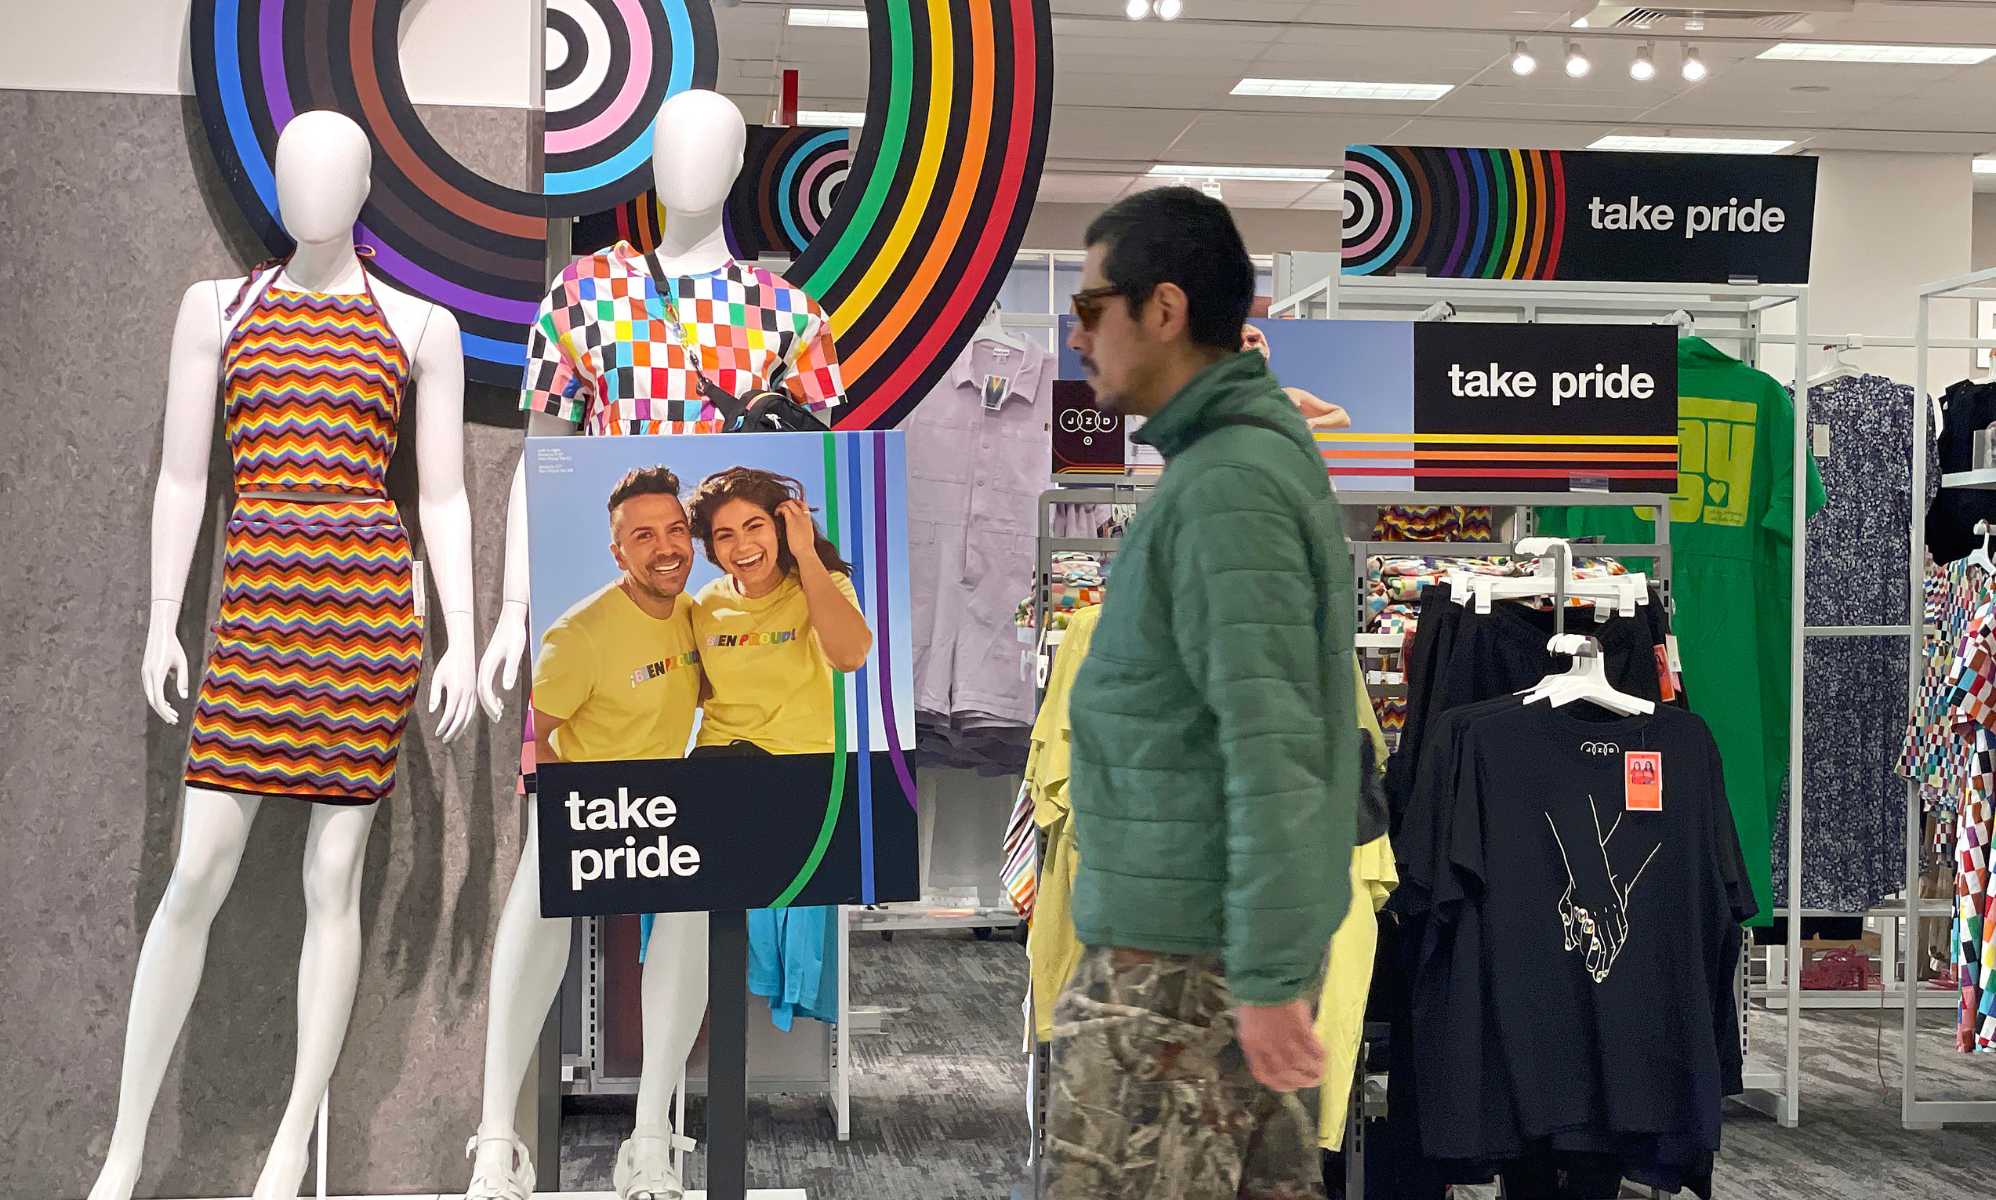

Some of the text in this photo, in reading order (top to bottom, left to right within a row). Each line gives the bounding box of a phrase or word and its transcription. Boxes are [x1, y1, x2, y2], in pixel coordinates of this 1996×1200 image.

[1588, 195, 1786, 239] take pride
[1448, 362, 1655, 406] take pride
[564, 787, 677, 831] take
[571, 835, 701, 891] pride
